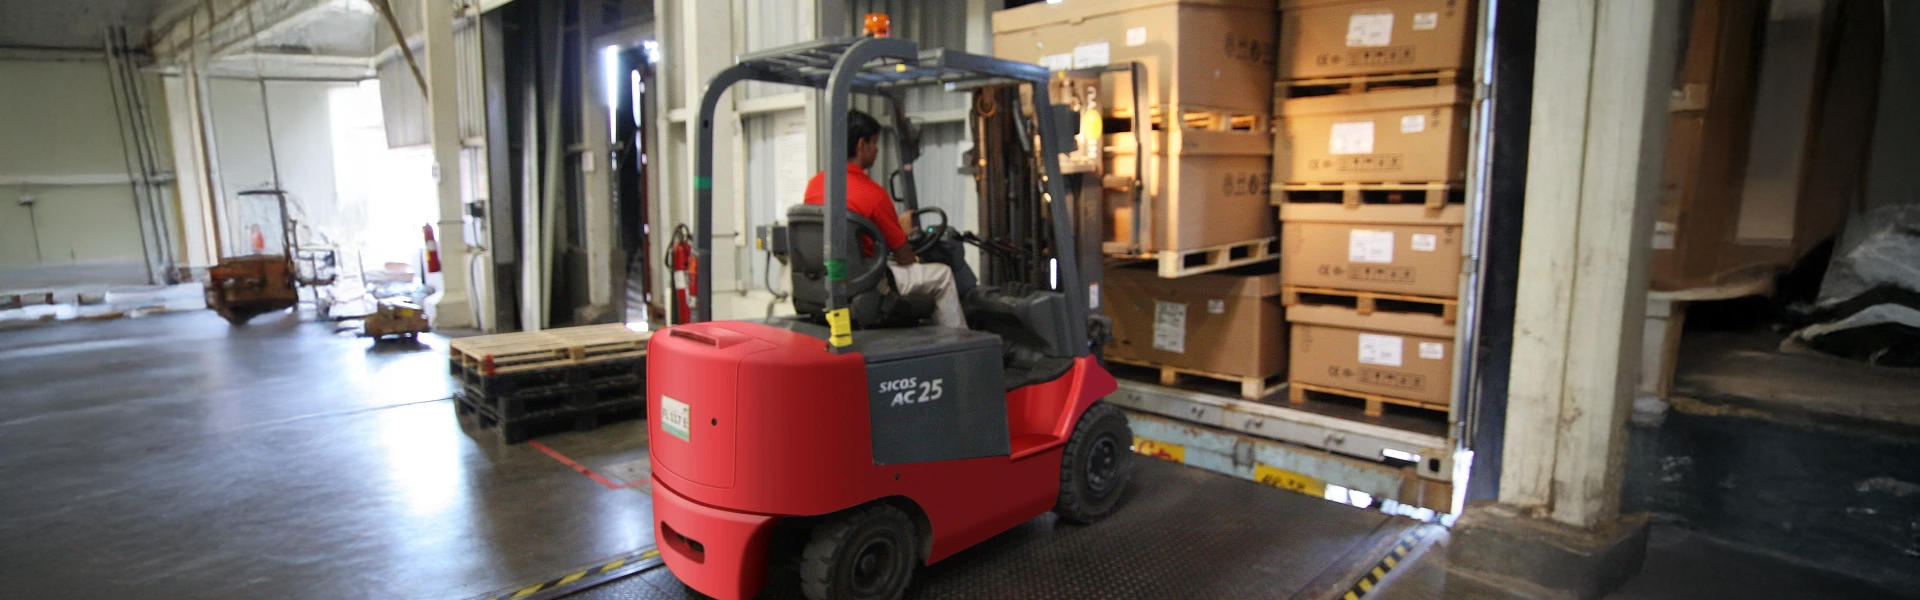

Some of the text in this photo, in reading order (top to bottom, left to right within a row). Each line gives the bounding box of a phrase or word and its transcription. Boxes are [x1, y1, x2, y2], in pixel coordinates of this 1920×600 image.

[878, 377, 917, 393] SICOS
[890, 378, 943, 407] AC 25
